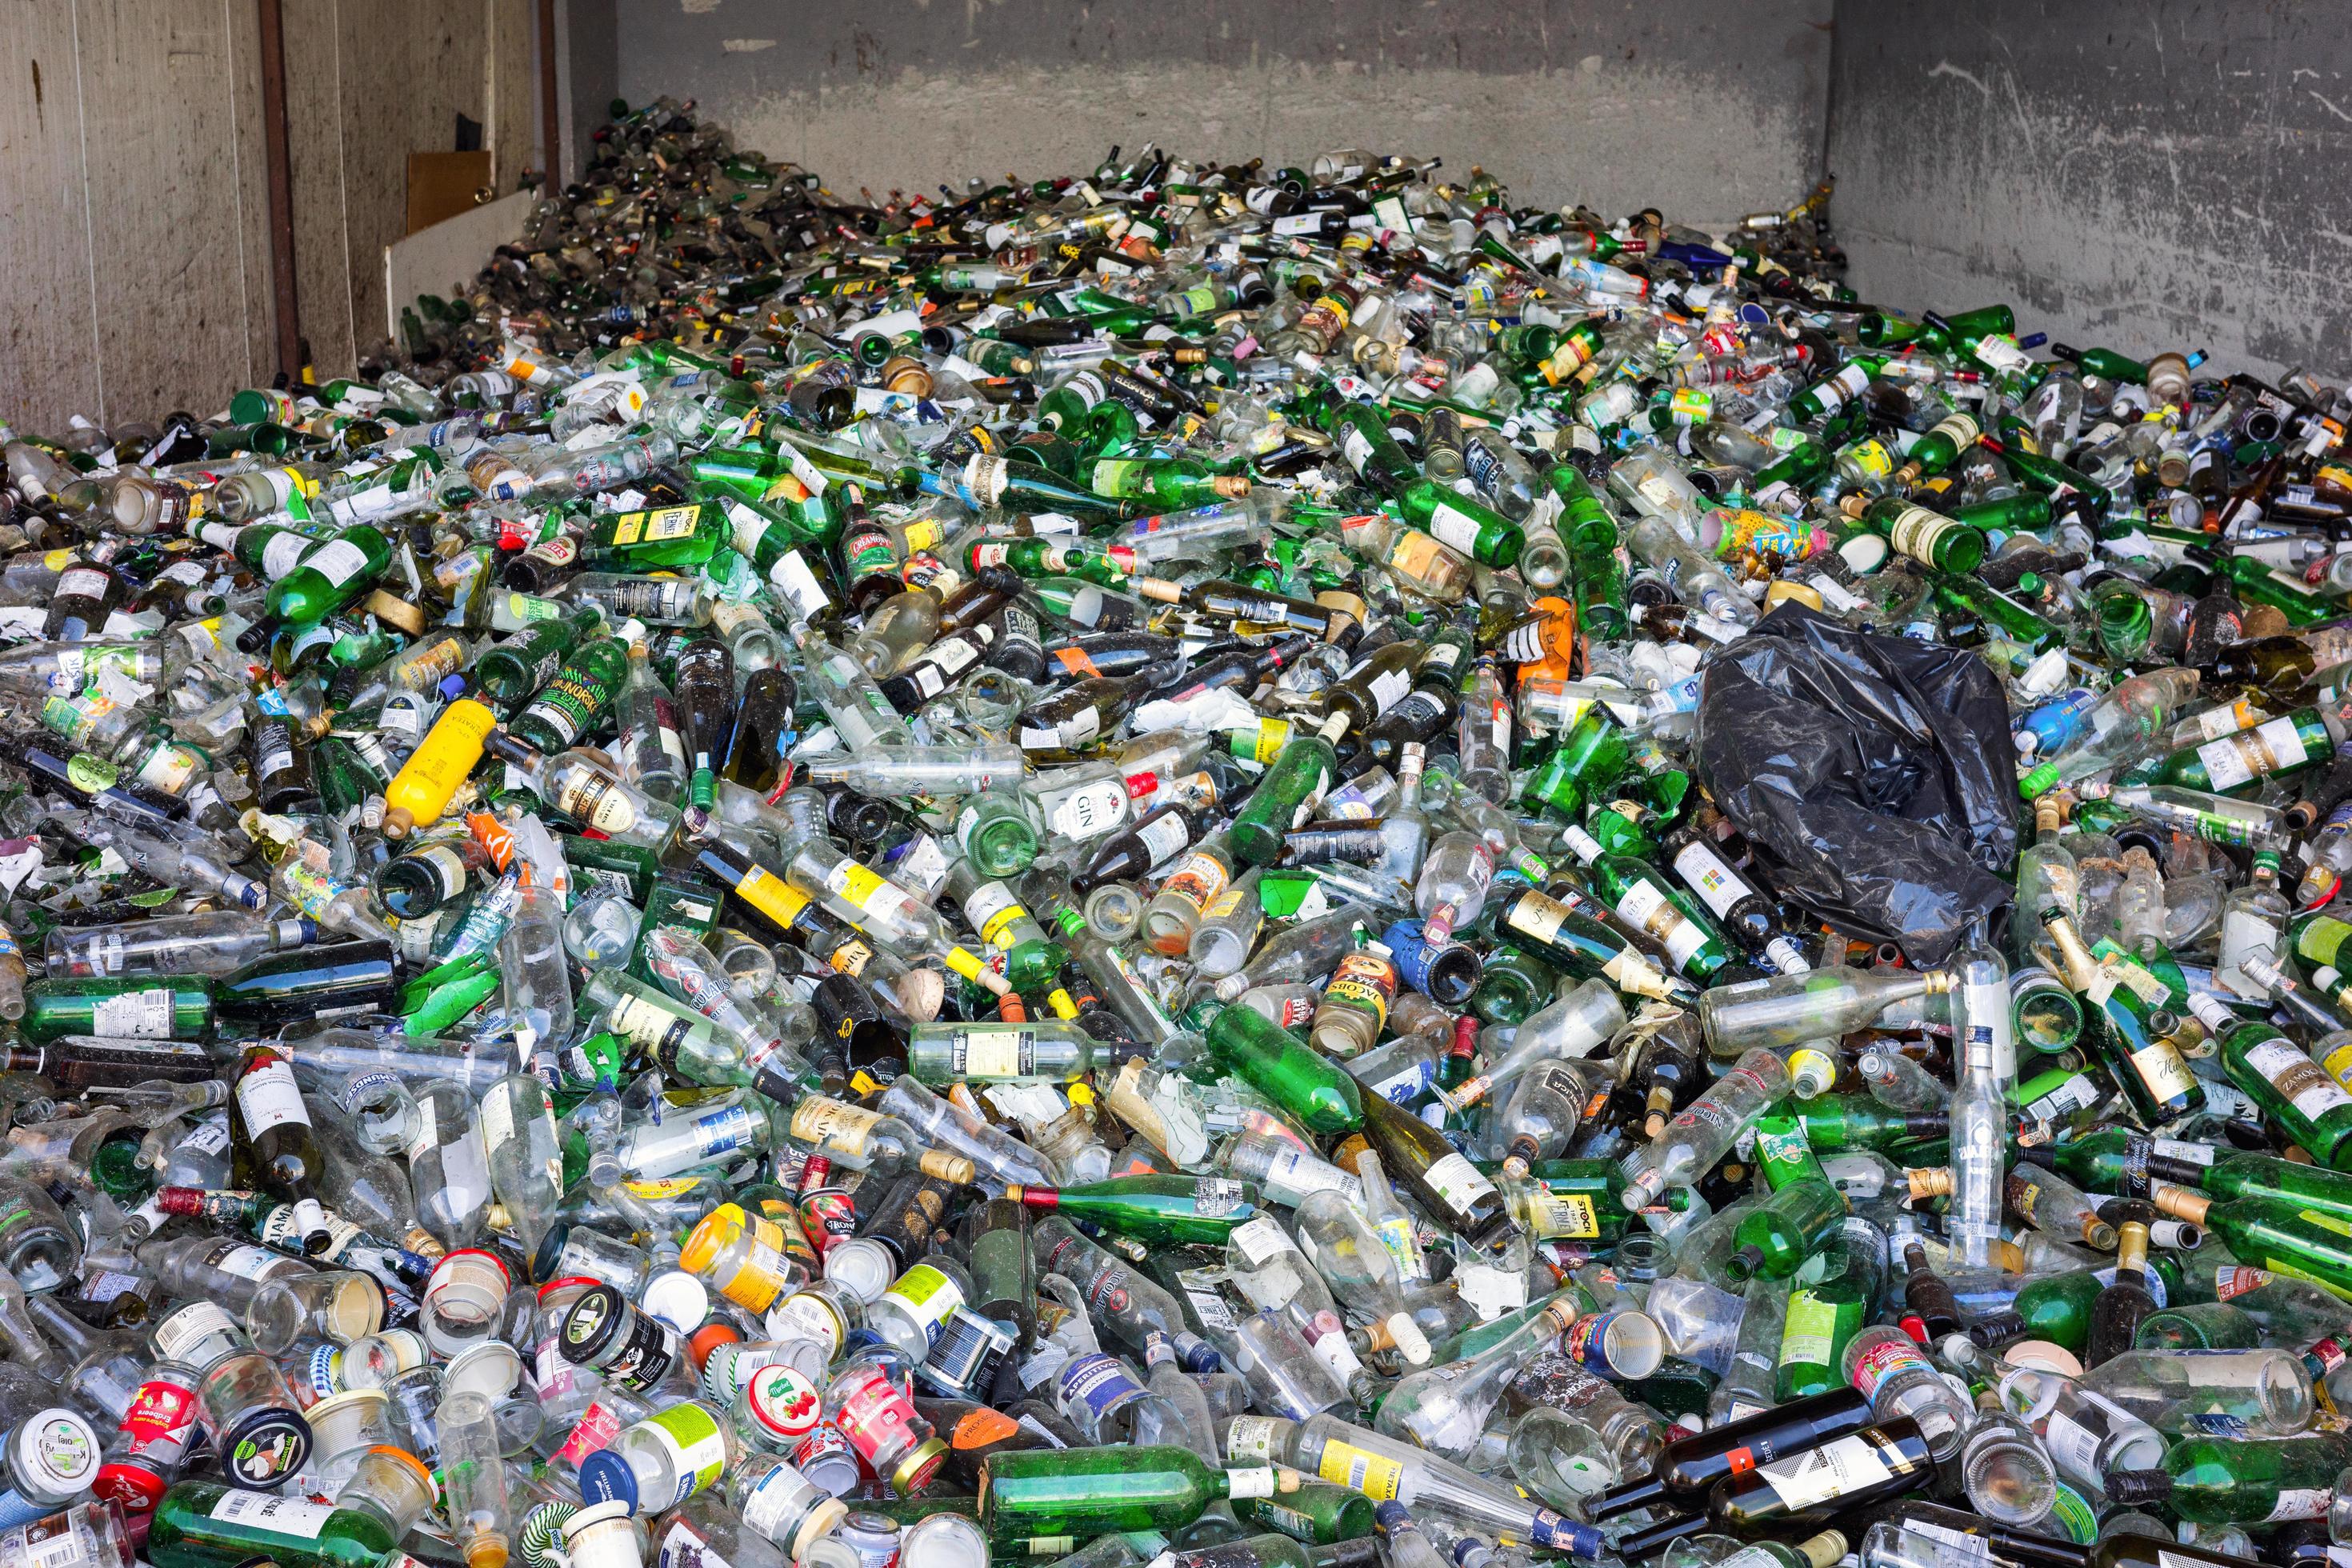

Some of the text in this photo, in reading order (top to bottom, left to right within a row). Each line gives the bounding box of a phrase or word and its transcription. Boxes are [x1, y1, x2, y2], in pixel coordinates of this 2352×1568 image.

[664, 512, 680, 536] FERNET
[683, 509, 695, 534] STOCK
[853, 534, 891, 553] CREAMONY
[1078, 796, 1094, 827] GIN
[690, 978, 731, 1011] COLAUS
[1330, 983, 1381, 1001] JACOBS
[344, 1073, 397, 1109] AMUNDSEN
[236, 1084, 258, 1138] PRESSBURG
[1578, 1200, 1592, 1233] STOCK
[769, 1382, 791, 1397] Maribel
[1068, 1361, 1119, 1397] APERITIVO
[1083, 1370, 1118, 1394] BIANCO
[137, 1409, 172, 1423] Erdbeere
[1385, 1466, 1398, 1500] METAXA
